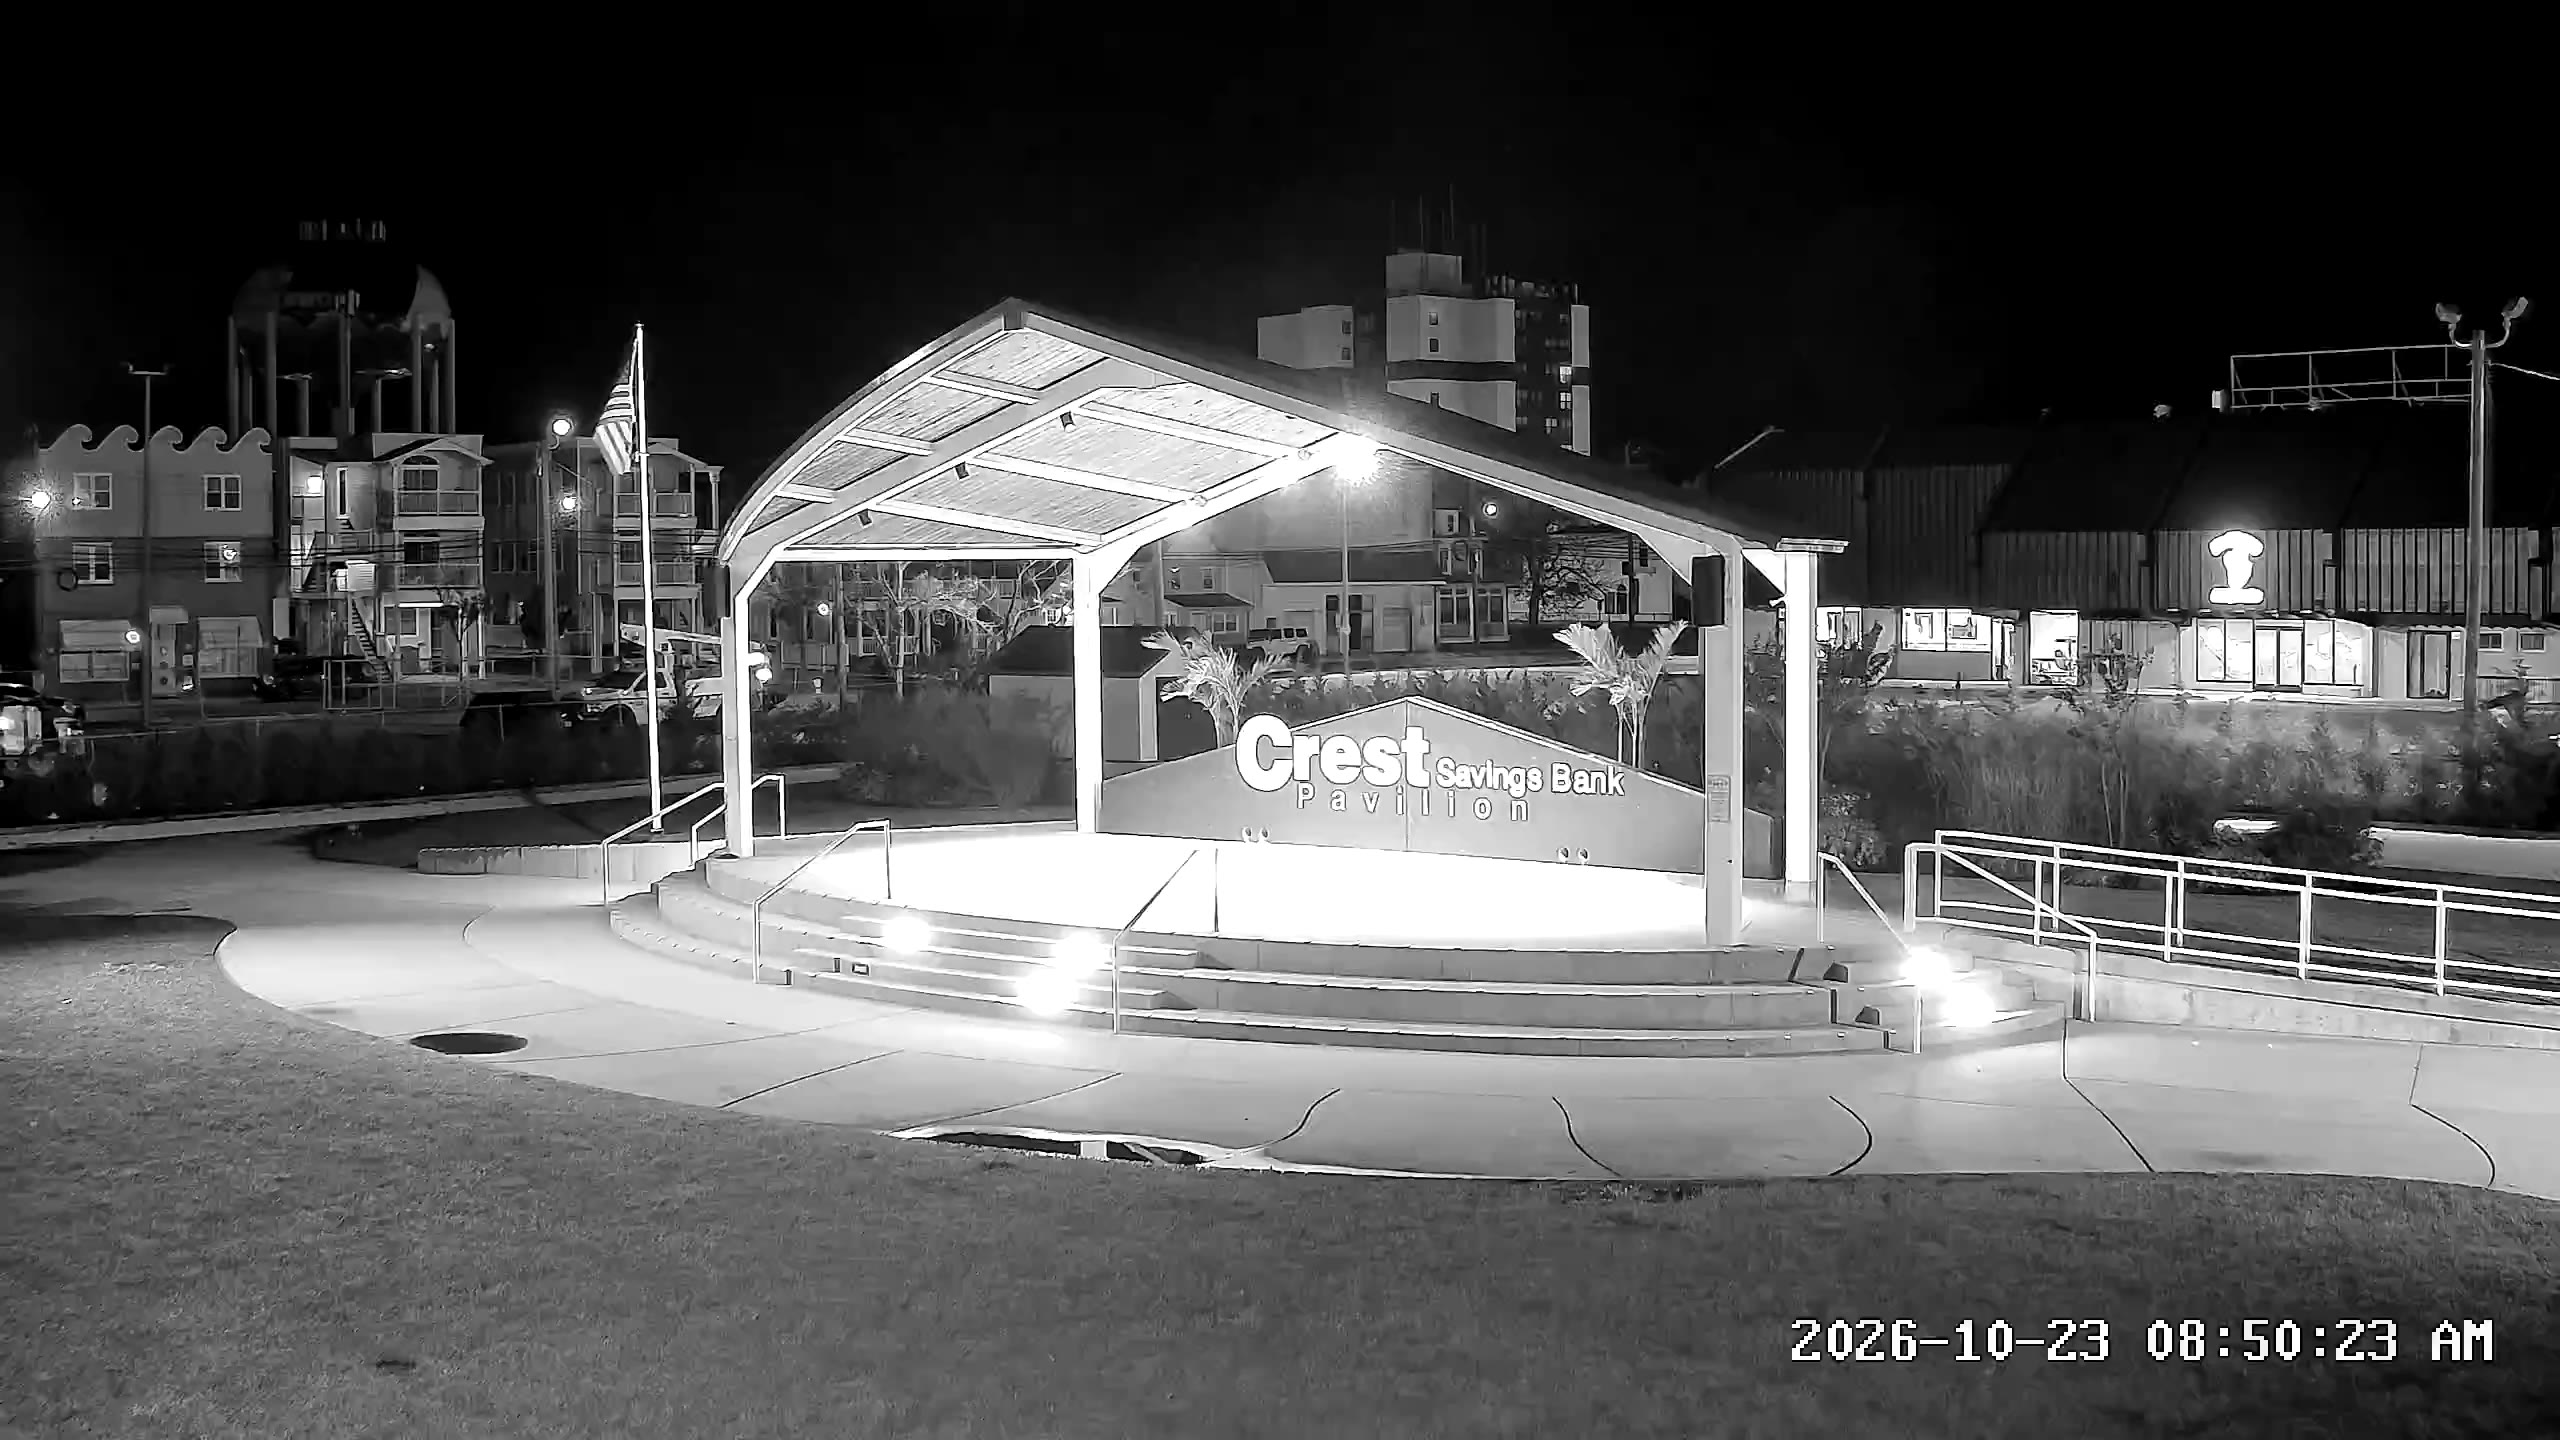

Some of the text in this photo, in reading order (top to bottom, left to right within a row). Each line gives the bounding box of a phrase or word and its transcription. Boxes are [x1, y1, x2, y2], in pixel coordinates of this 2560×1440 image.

[1235, 713, 1626, 799] Crest Savings Bank
[1296, 781, 1529, 822] Pavilion
